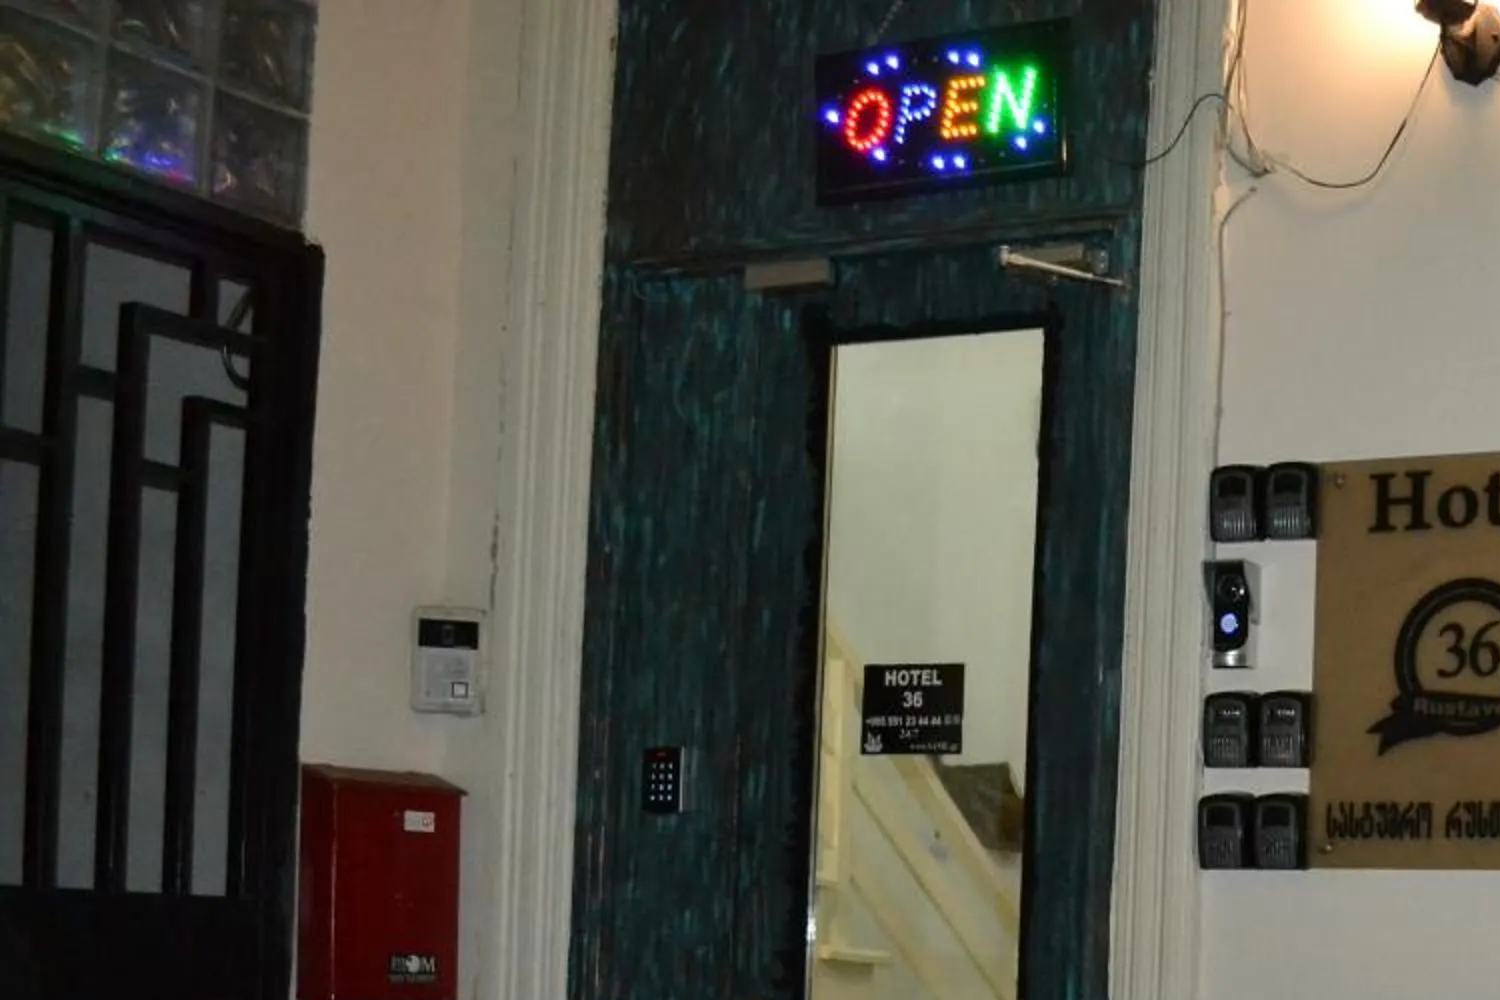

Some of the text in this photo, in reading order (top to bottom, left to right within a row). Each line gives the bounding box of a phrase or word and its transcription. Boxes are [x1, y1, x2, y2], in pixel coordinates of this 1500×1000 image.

[845, 63, 1037, 151] OPEN
[884, 669, 943, 687] HOTEL
[902, 691, 923, 708] 36
